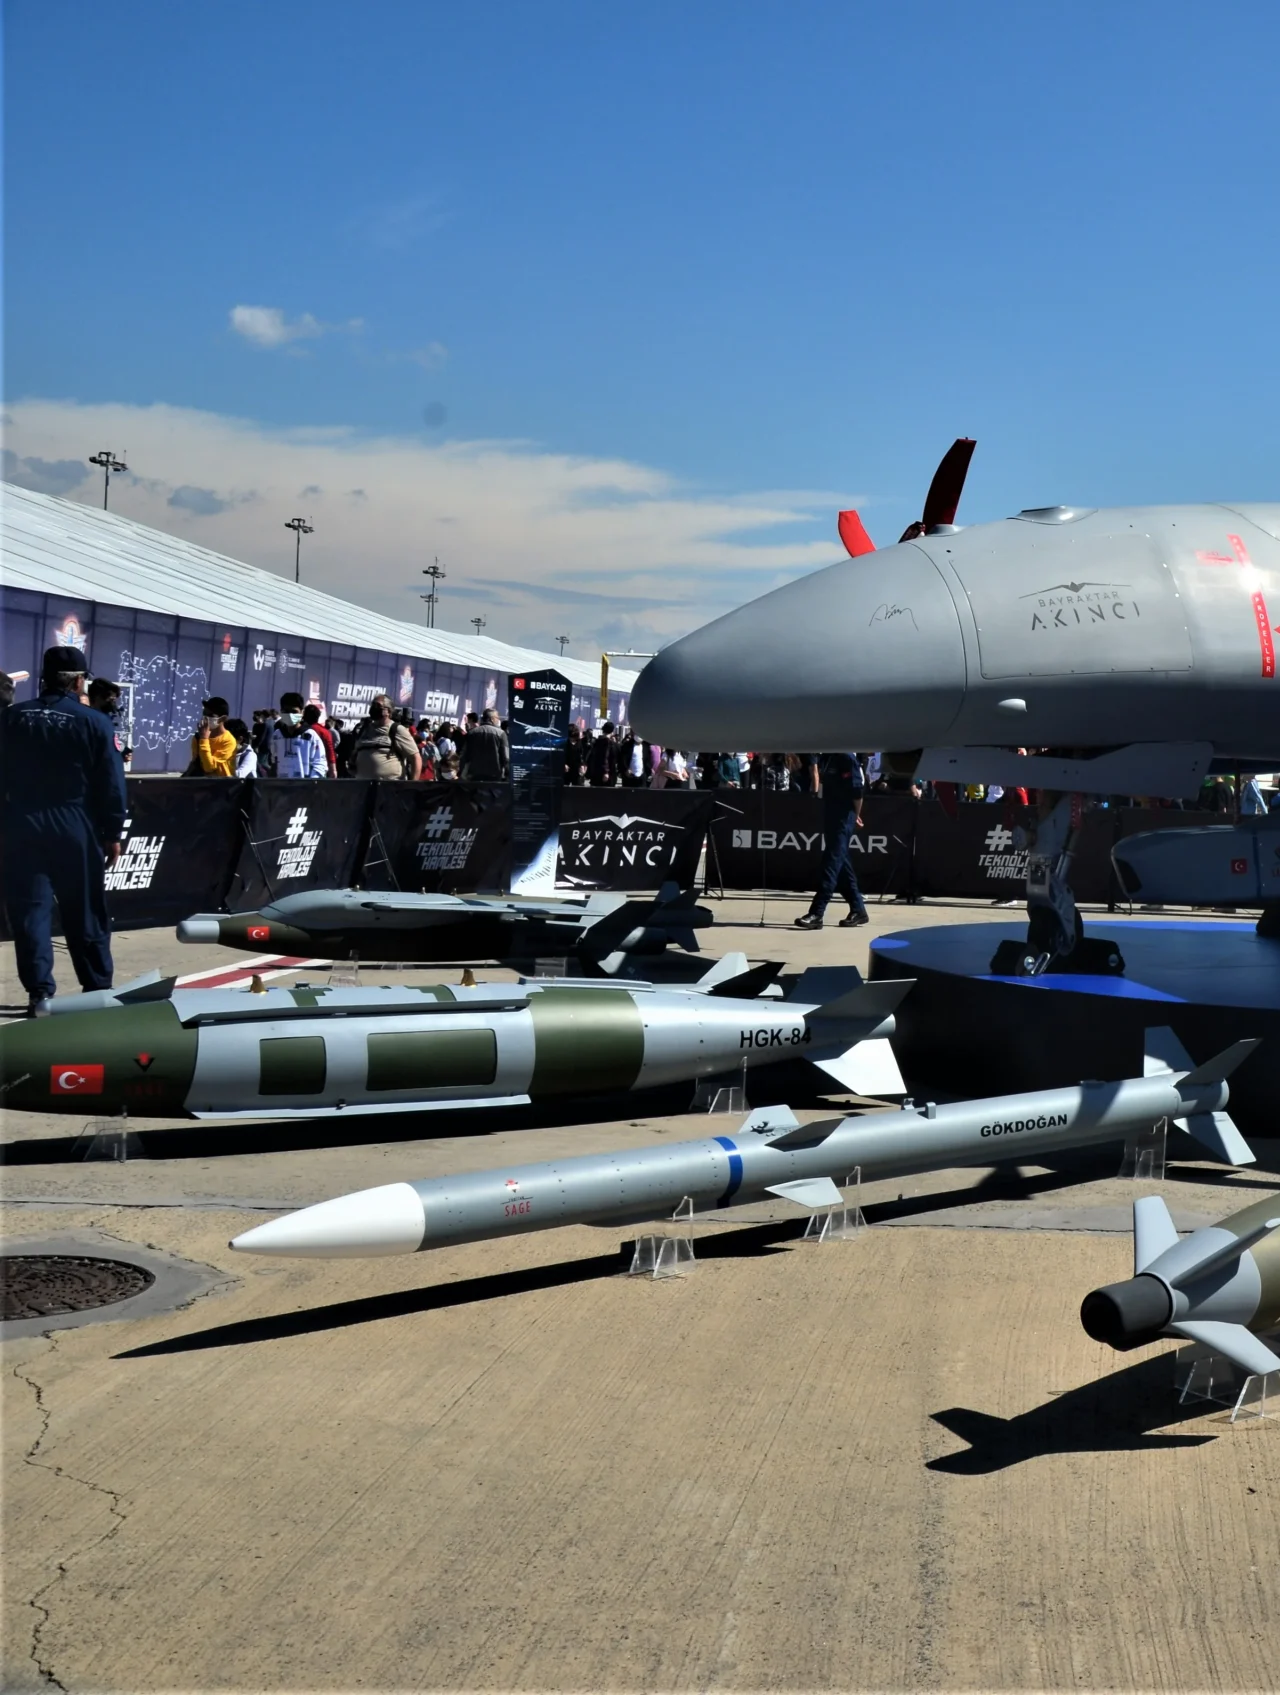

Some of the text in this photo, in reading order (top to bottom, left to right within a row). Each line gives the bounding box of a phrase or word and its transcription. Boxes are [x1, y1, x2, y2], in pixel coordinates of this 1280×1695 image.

[1038, 591, 1120, 608] BAYRAKTAR
[1031, 601, 1140, 631] AKINCI
[1254, 596, 1272, 673] PROPELLER
[536, 682, 567, 692] BAYKAR
[571, 829, 666, 843] BAYRAKTAR
[757, 830, 888, 854] BAYAR
[104, 854, 159, 873] NOLOJİ
[979, 854, 1031, 869] TEKNOL
[104, 870, 154, 891] AMLESİ
[986, 866, 1028, 880] HAMLE
[740, 1026, 812, 1049] HGK-84
[980, 1113, 1068, 1138] GÖKDOĞAN
[504, 1200, 531, 1217] SAGE
